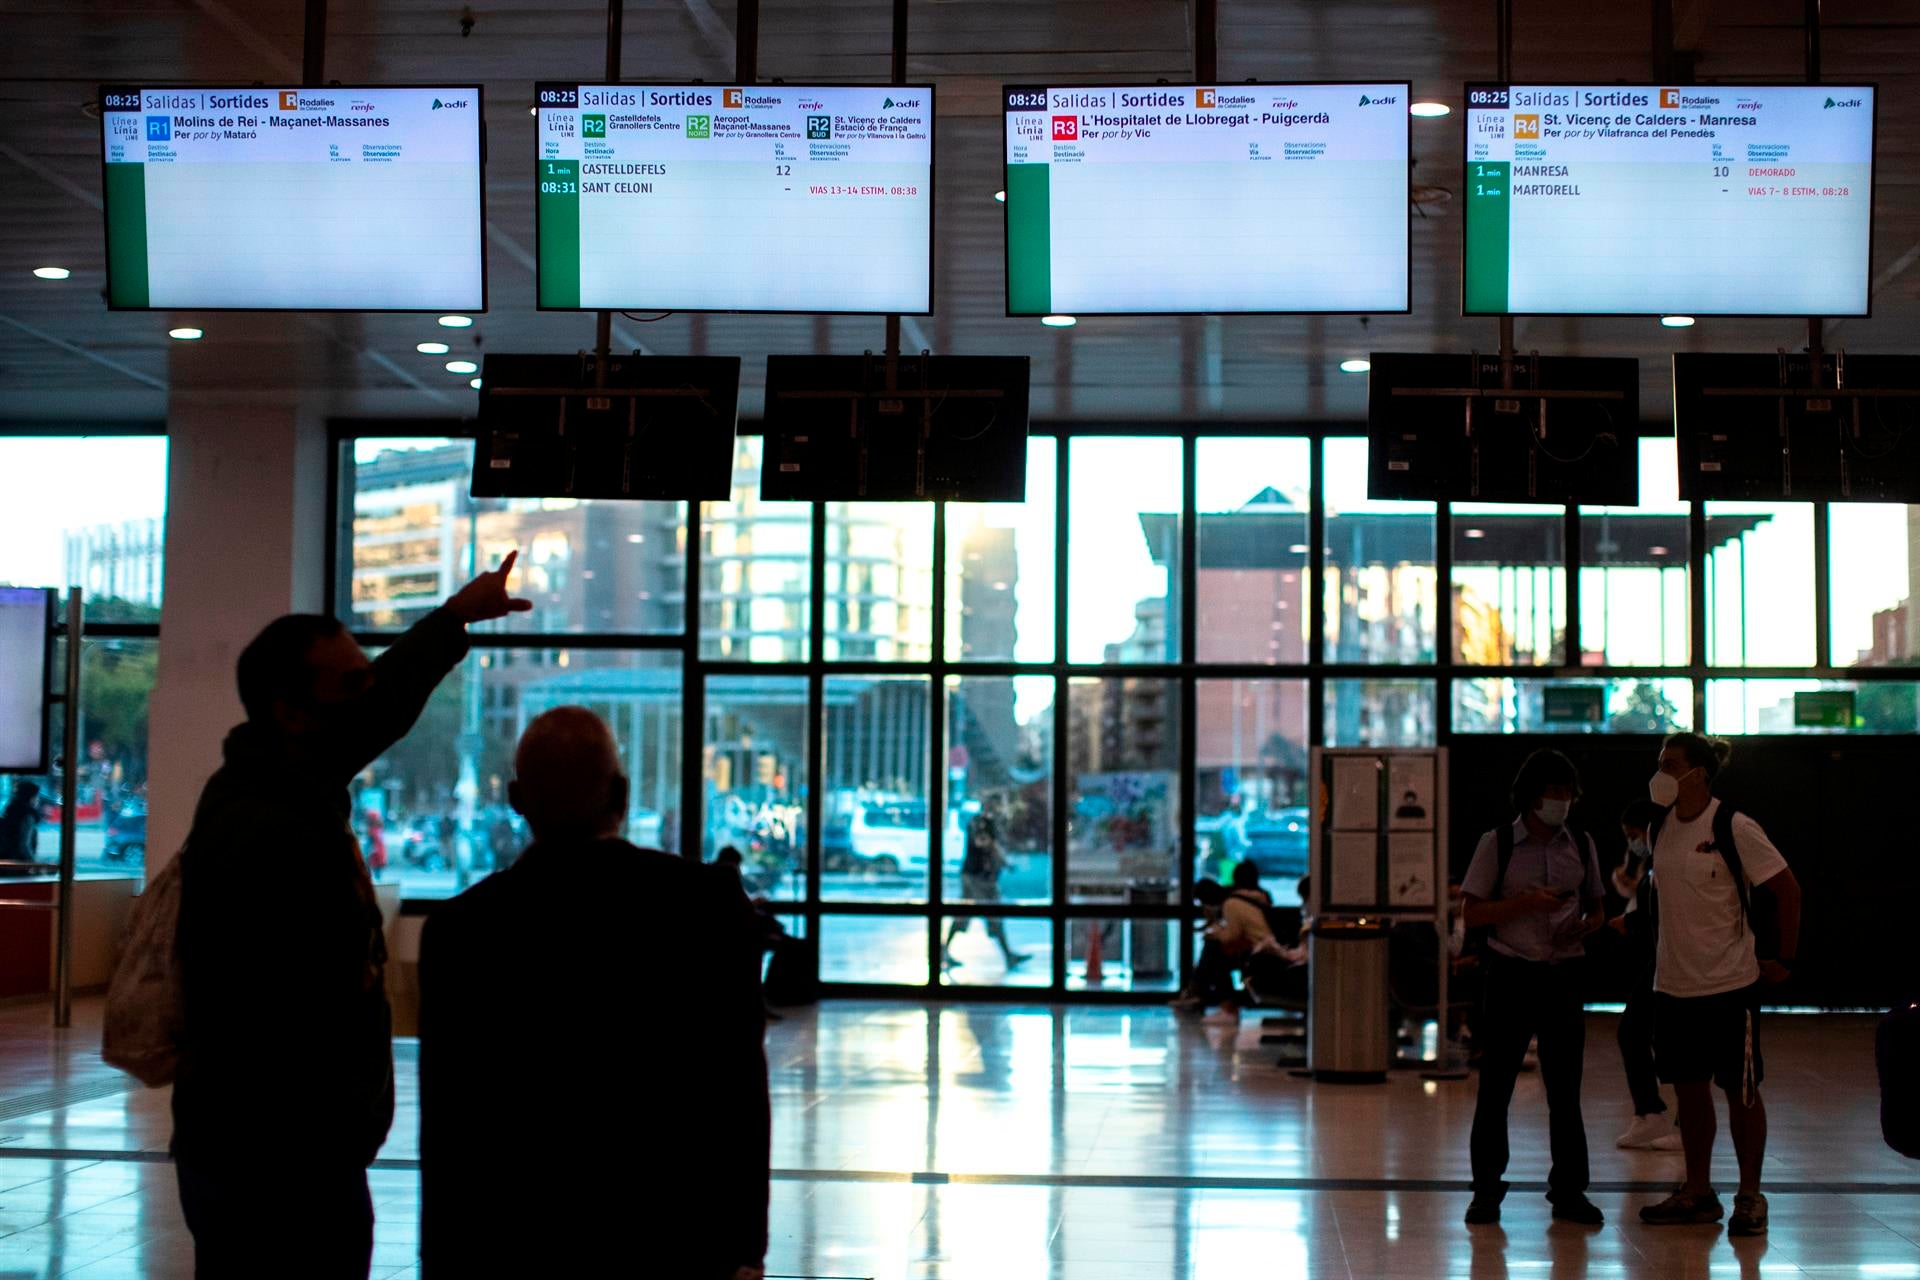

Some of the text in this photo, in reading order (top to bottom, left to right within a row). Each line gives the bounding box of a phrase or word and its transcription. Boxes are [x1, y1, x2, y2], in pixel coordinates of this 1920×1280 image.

[105, 94, 139, 107] 08:25
[146, 95, 269, 109] Salidas Sortides
[540, 91, 576, 103] 08:25
[584, 91, 713, 106] Salidas Sortides
[744, 96, 782, 105] Rodalies
[1009, 94, 1046, 106] 08:26
[1053, 93, 1185, 108] Salidas Sortides
[1217, 96, 1256, 104] Rodalies
[1470, 91, 1508, 103] 08:25
[1515, 92, 1649, 106] Salidas Sortides
[1682, 96, 1720, 105] Rodalies
[351, 103, 375, 113] renfe
[798, 101, 824, 112] renfe
[1272, 100, 1298, 110] renfe
[1736, 101, 1763, 111] renfe
[174, 116, 390, 130] Molins de Rei Maçanet-Massanes
[609, 114, 662, 123] Castelldefels
[688, 118, 708, 130] R2
[714, 115, 750, 124] Aeroport
[834, 116, 921, 125] St. Vicenç de Calders
[1082, 112, 1330, 128] L'Hospitalet de Llobregat Puigcerdà
[1543, 114, 1757, 129] St. Vicenç de Calders Manresa
[150, 123, 168, 135] R1
[584, 119, 604, 133] R2
[609, 122, 681, 130] Granollers Centre
[713, 123, 791, 132] Maçanet-Massanes
[809, 118, 829, 131] R2
[834, 123, 865, 131] Estació
[880, 124, 908, 133] França
[1053, 123, 1076, 135] R3
[1515, 120, 1538, 133] R4
[174, 130, 256, 141] Per por by Mataró
[1082, 129, 1151, 141] Per por by Vic
[1544, 129, 1715, 139] Per por by Vilafranca del Penedès
[547, 164, 554, 174] 1
[582, 163, 666, 175] CASTELLDEFELS
[776, 165, 791, 176] 12
[1477, 165, 1484, 176] 1
[1513, 166, 1569, 176] MANRESA
[1714, 166, 1730, 177] 10
[1749, 168, 1796, 177] DEMORADO
[541, 182, 576, 193] 08:31
[582, 182, 653, 193] SANT CELONI
[810, 186, 917, 195] VIAS 13-14 ESTIM. 08:38
[1477, 185, 1484, 195] 1
[1513, 185, 1581, 196] MARTORELL
[1748, 187, 1766, 196] VIAS
[1792, 187, 1819, 196] ESTIM.
[1823, 187, 1849, 196] 08:28
